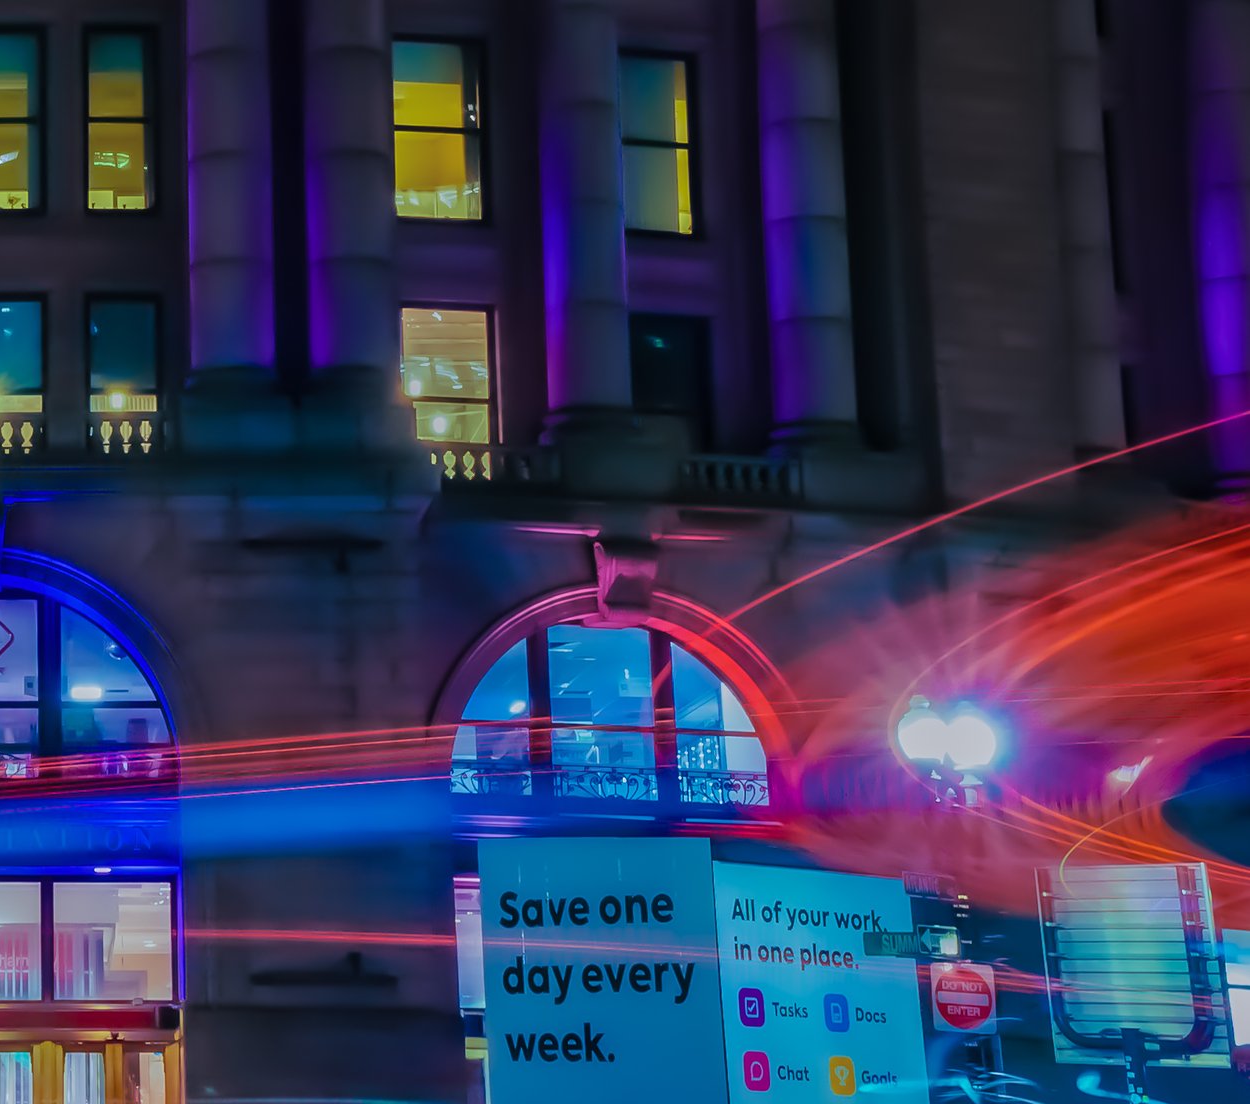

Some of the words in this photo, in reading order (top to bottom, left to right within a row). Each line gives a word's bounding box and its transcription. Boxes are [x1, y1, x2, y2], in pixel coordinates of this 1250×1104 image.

[499, 891, 589, 929] Save
[599, 893, 674, 925] one
[732, 898, 755, 922] All
[761, 900, 783, 924] of
[787, 907, 831, 931] your
[734, 936, 752, 960] in
[758, 944, 794, 963] one
[800, 943, 860, 970] place.
[502, 956, 572, 1004] day
[582, 961, 695, 1004] every
[941, 979, 959, 991] DO
[962, 981, 984, 992] NOT
[772, 1002, 808, 1019] Tasks
[855, 1007, 887, 1024] Docs
[947, 1005, 981, 1017] ENTER
[505, 1022, 616, 1062] week.
[777, 1065, 810, 1082] Chat
[861, 1071, 898, 1087] Goals
